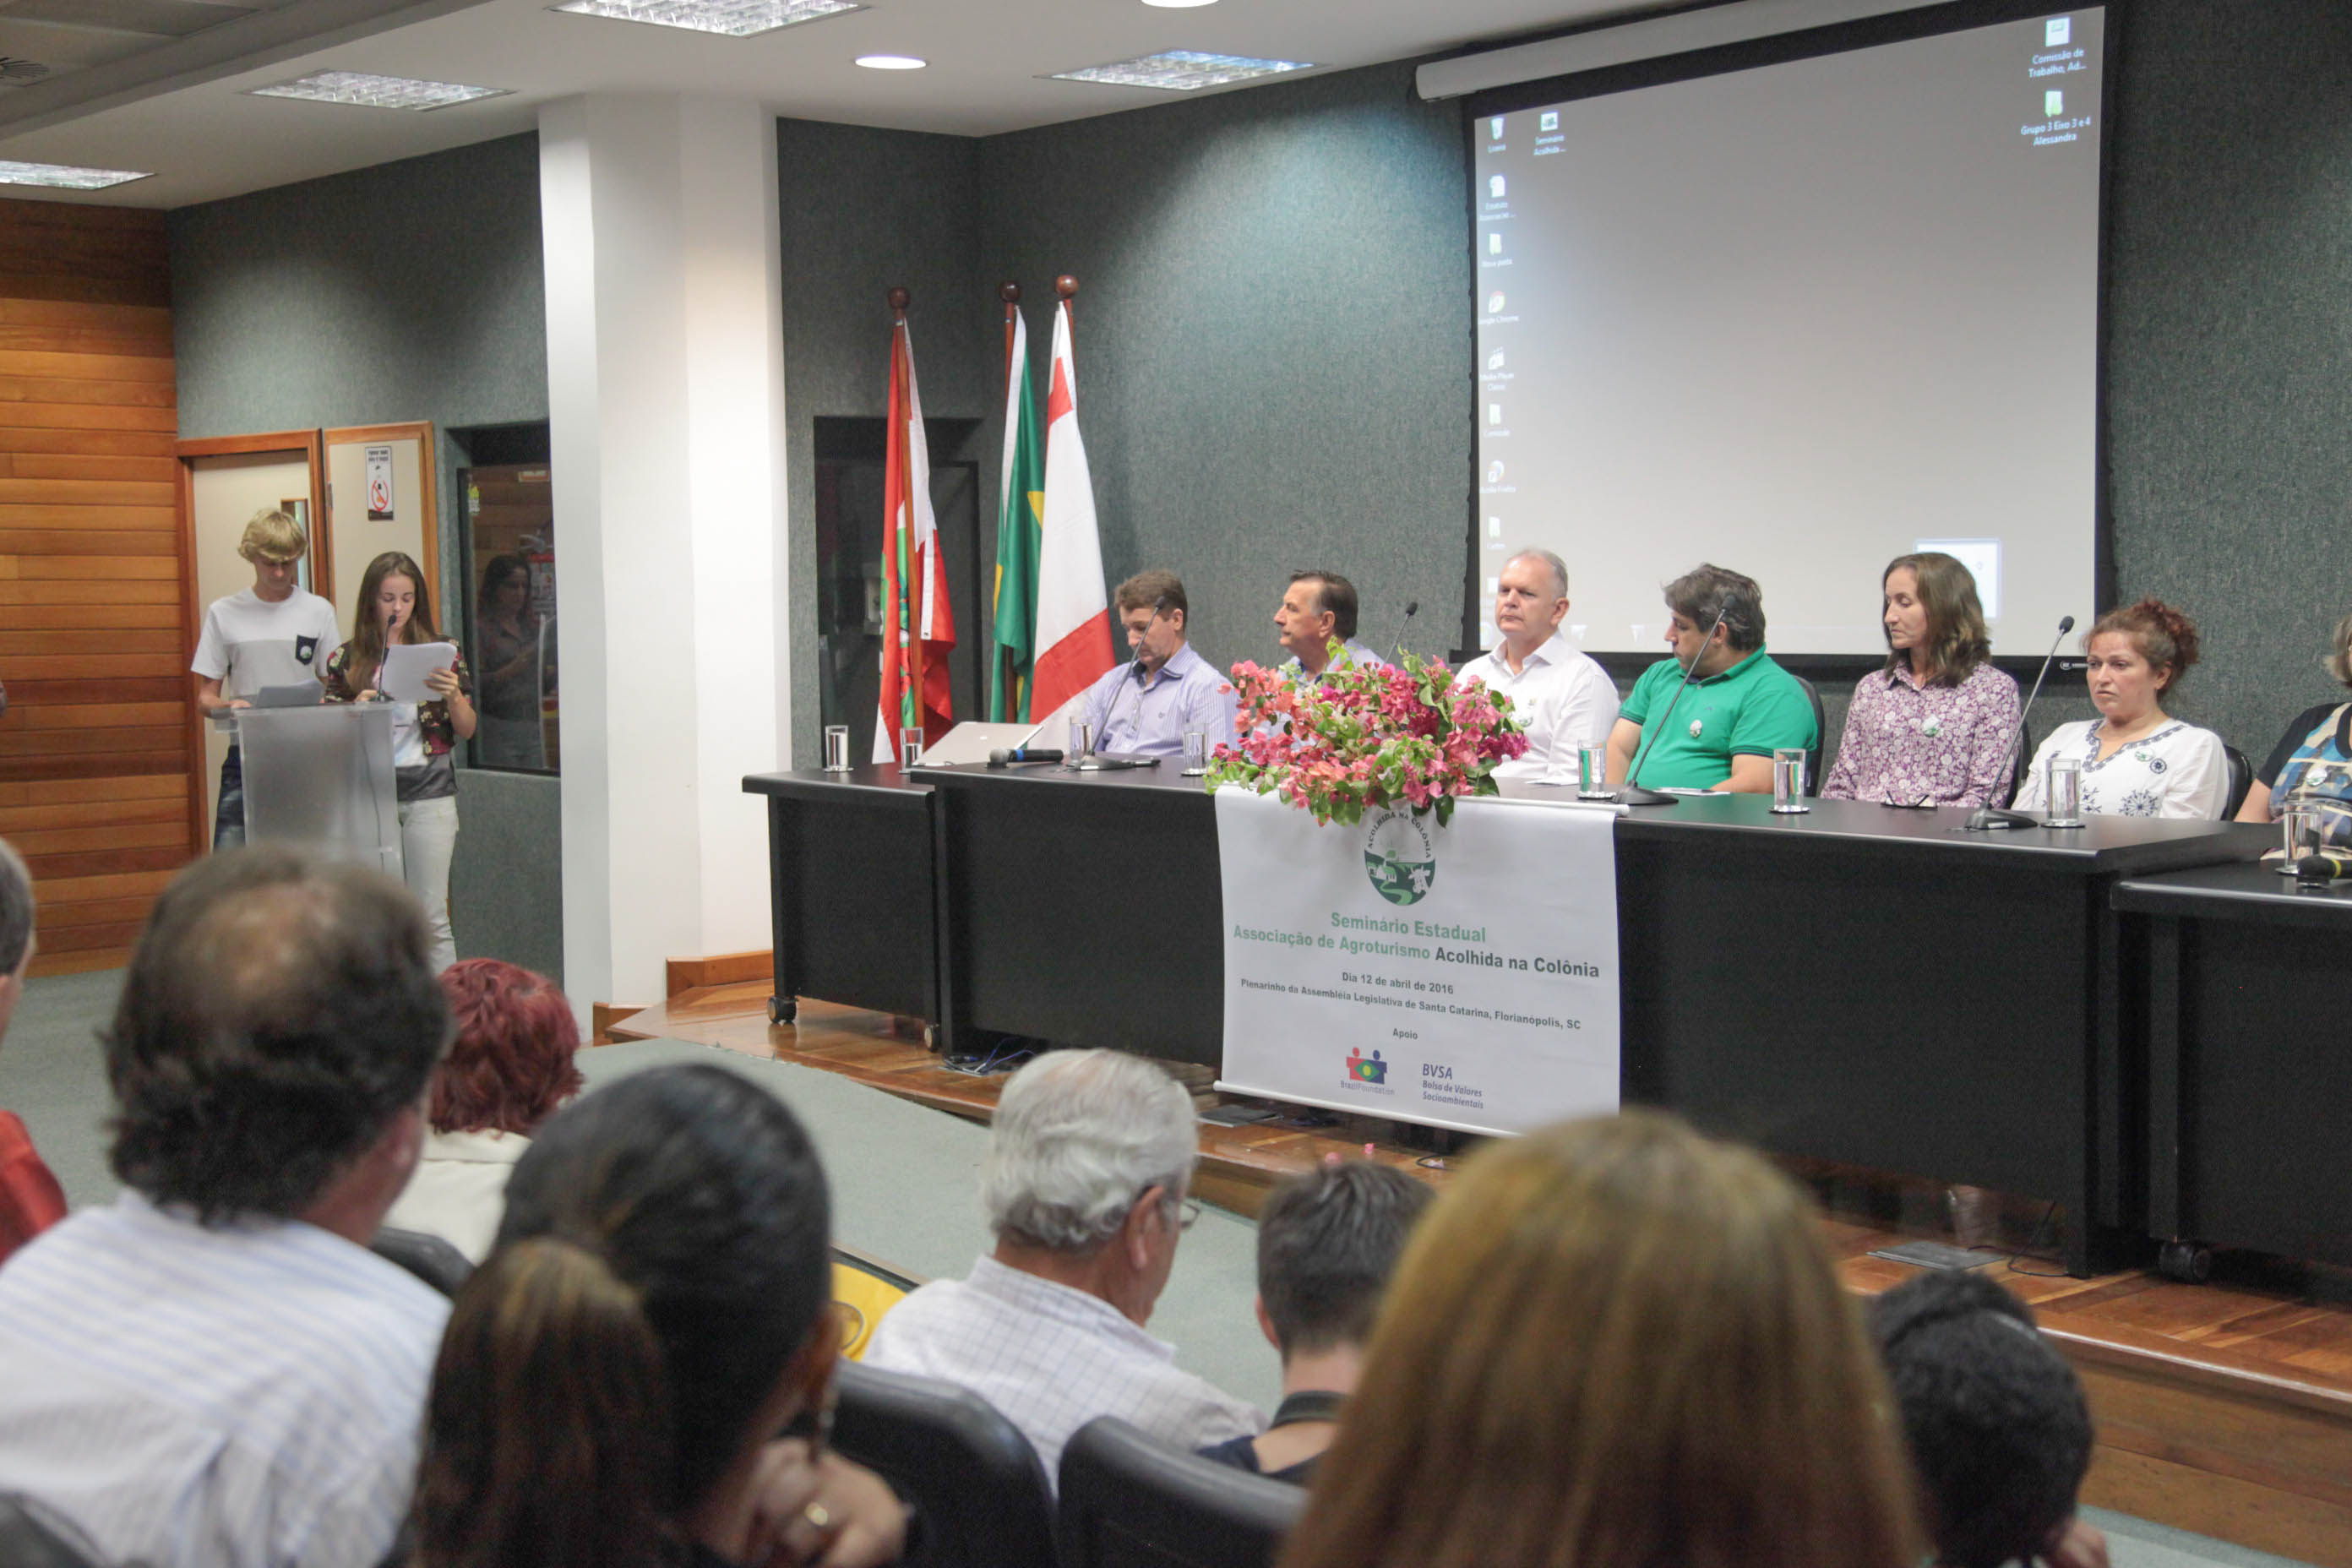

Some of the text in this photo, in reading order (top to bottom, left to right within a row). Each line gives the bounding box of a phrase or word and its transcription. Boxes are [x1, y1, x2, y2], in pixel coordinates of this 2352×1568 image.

[2073, 48, 2084, 57] de
[2021, 125, 2045, 136] Grupo
[2047, 122, 2053, 132] 3
[2072, 117, 2077, 128] 3
[2033, 132, 2077, 147] Alessandra
[1368, 812, 1396, 849] ACOLHIDA
[1398, 812, 1409, 820] NA
[1331, 912, 1486, 943] Seminário Estadual
[1233, 925, 1599, 977] Associação de Agroturismo Acolhida na Colônia
[1342, 972, 1454, 994] Dia 12 de abril de 2016
[1241, 978, 1286, 993] Plenarinho
[1288, 984, 1298, 994] da
[1353, 993, 1402, 1007] Legislativa
[1405, 999, 1416, 1009] de
[1418, 1000, 1446, 1013] Santa
[1449, 1005, 1492, 1021] Catarina,
[1494, 1010, 1563, 1029] Florianópolis,
[1566, 1019, 1581, 1030] SC
[1392, 1028, 1418, 1040] Apoio
[1423, 1064, 1453, 1080] BVSA
[1423, 1081, 1483, 1097] Bolsa de Valores
[1423, 1092, 1484, 1109] Socioambientais
